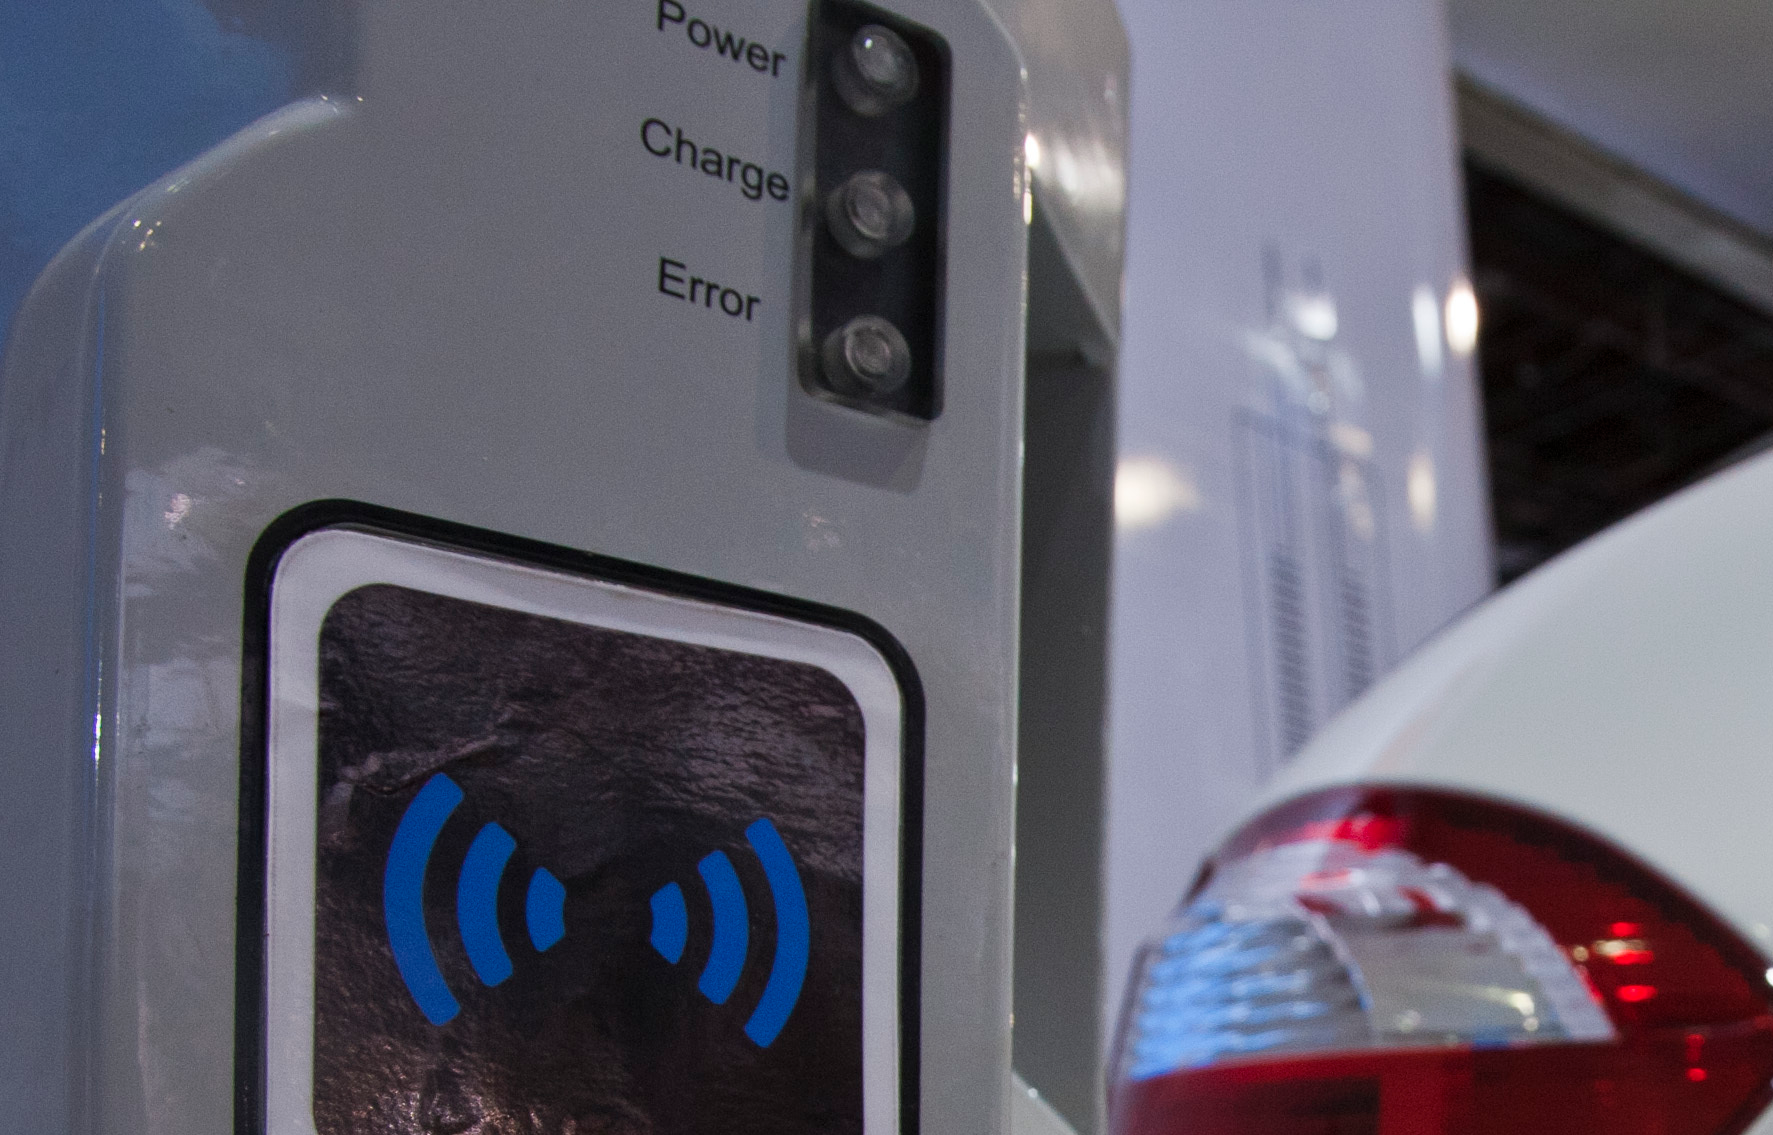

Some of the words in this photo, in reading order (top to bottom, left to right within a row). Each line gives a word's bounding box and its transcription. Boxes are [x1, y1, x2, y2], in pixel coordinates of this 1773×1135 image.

[656, 0, 787, 78] Power
[640, 117, 790, 202] Charge
[657, 256, 761, 322] Error
